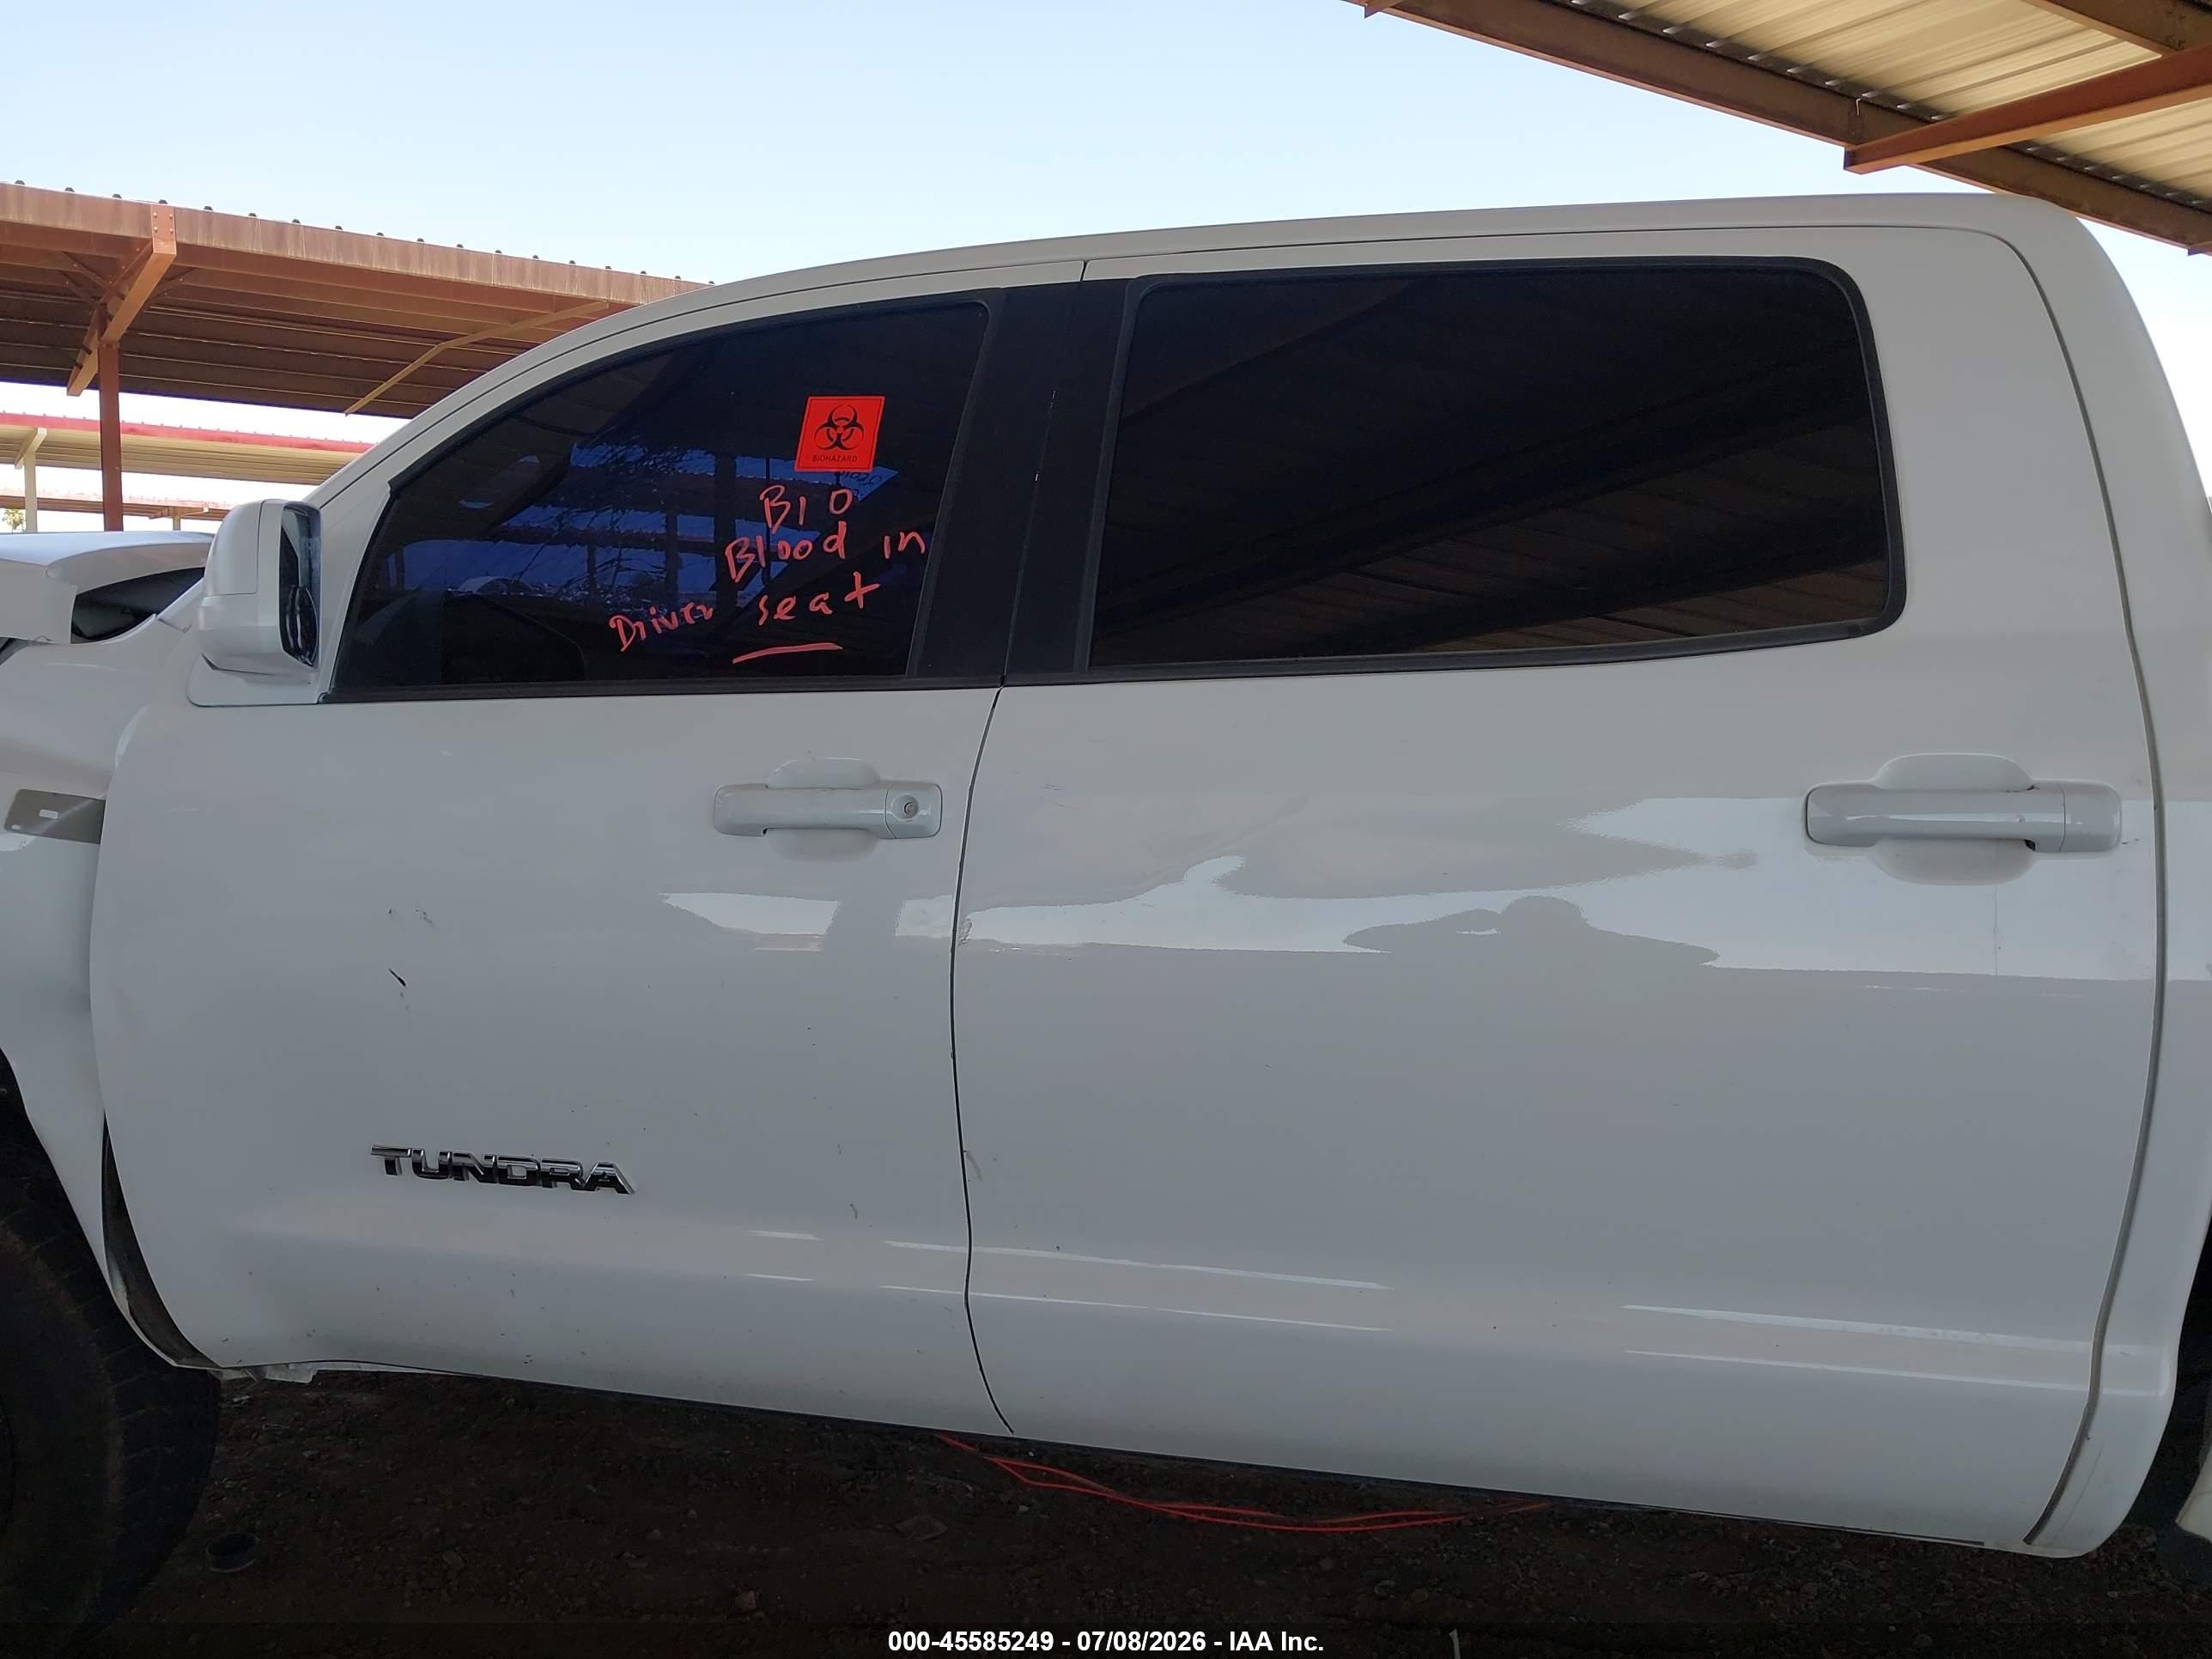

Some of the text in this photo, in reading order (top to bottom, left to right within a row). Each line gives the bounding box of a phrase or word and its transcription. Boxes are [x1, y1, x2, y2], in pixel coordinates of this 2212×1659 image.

[725, 520, 847, 582] Blood
[757, 571, 881, 625] seat
[371, 1145, 635, 1195] TUNDRA
